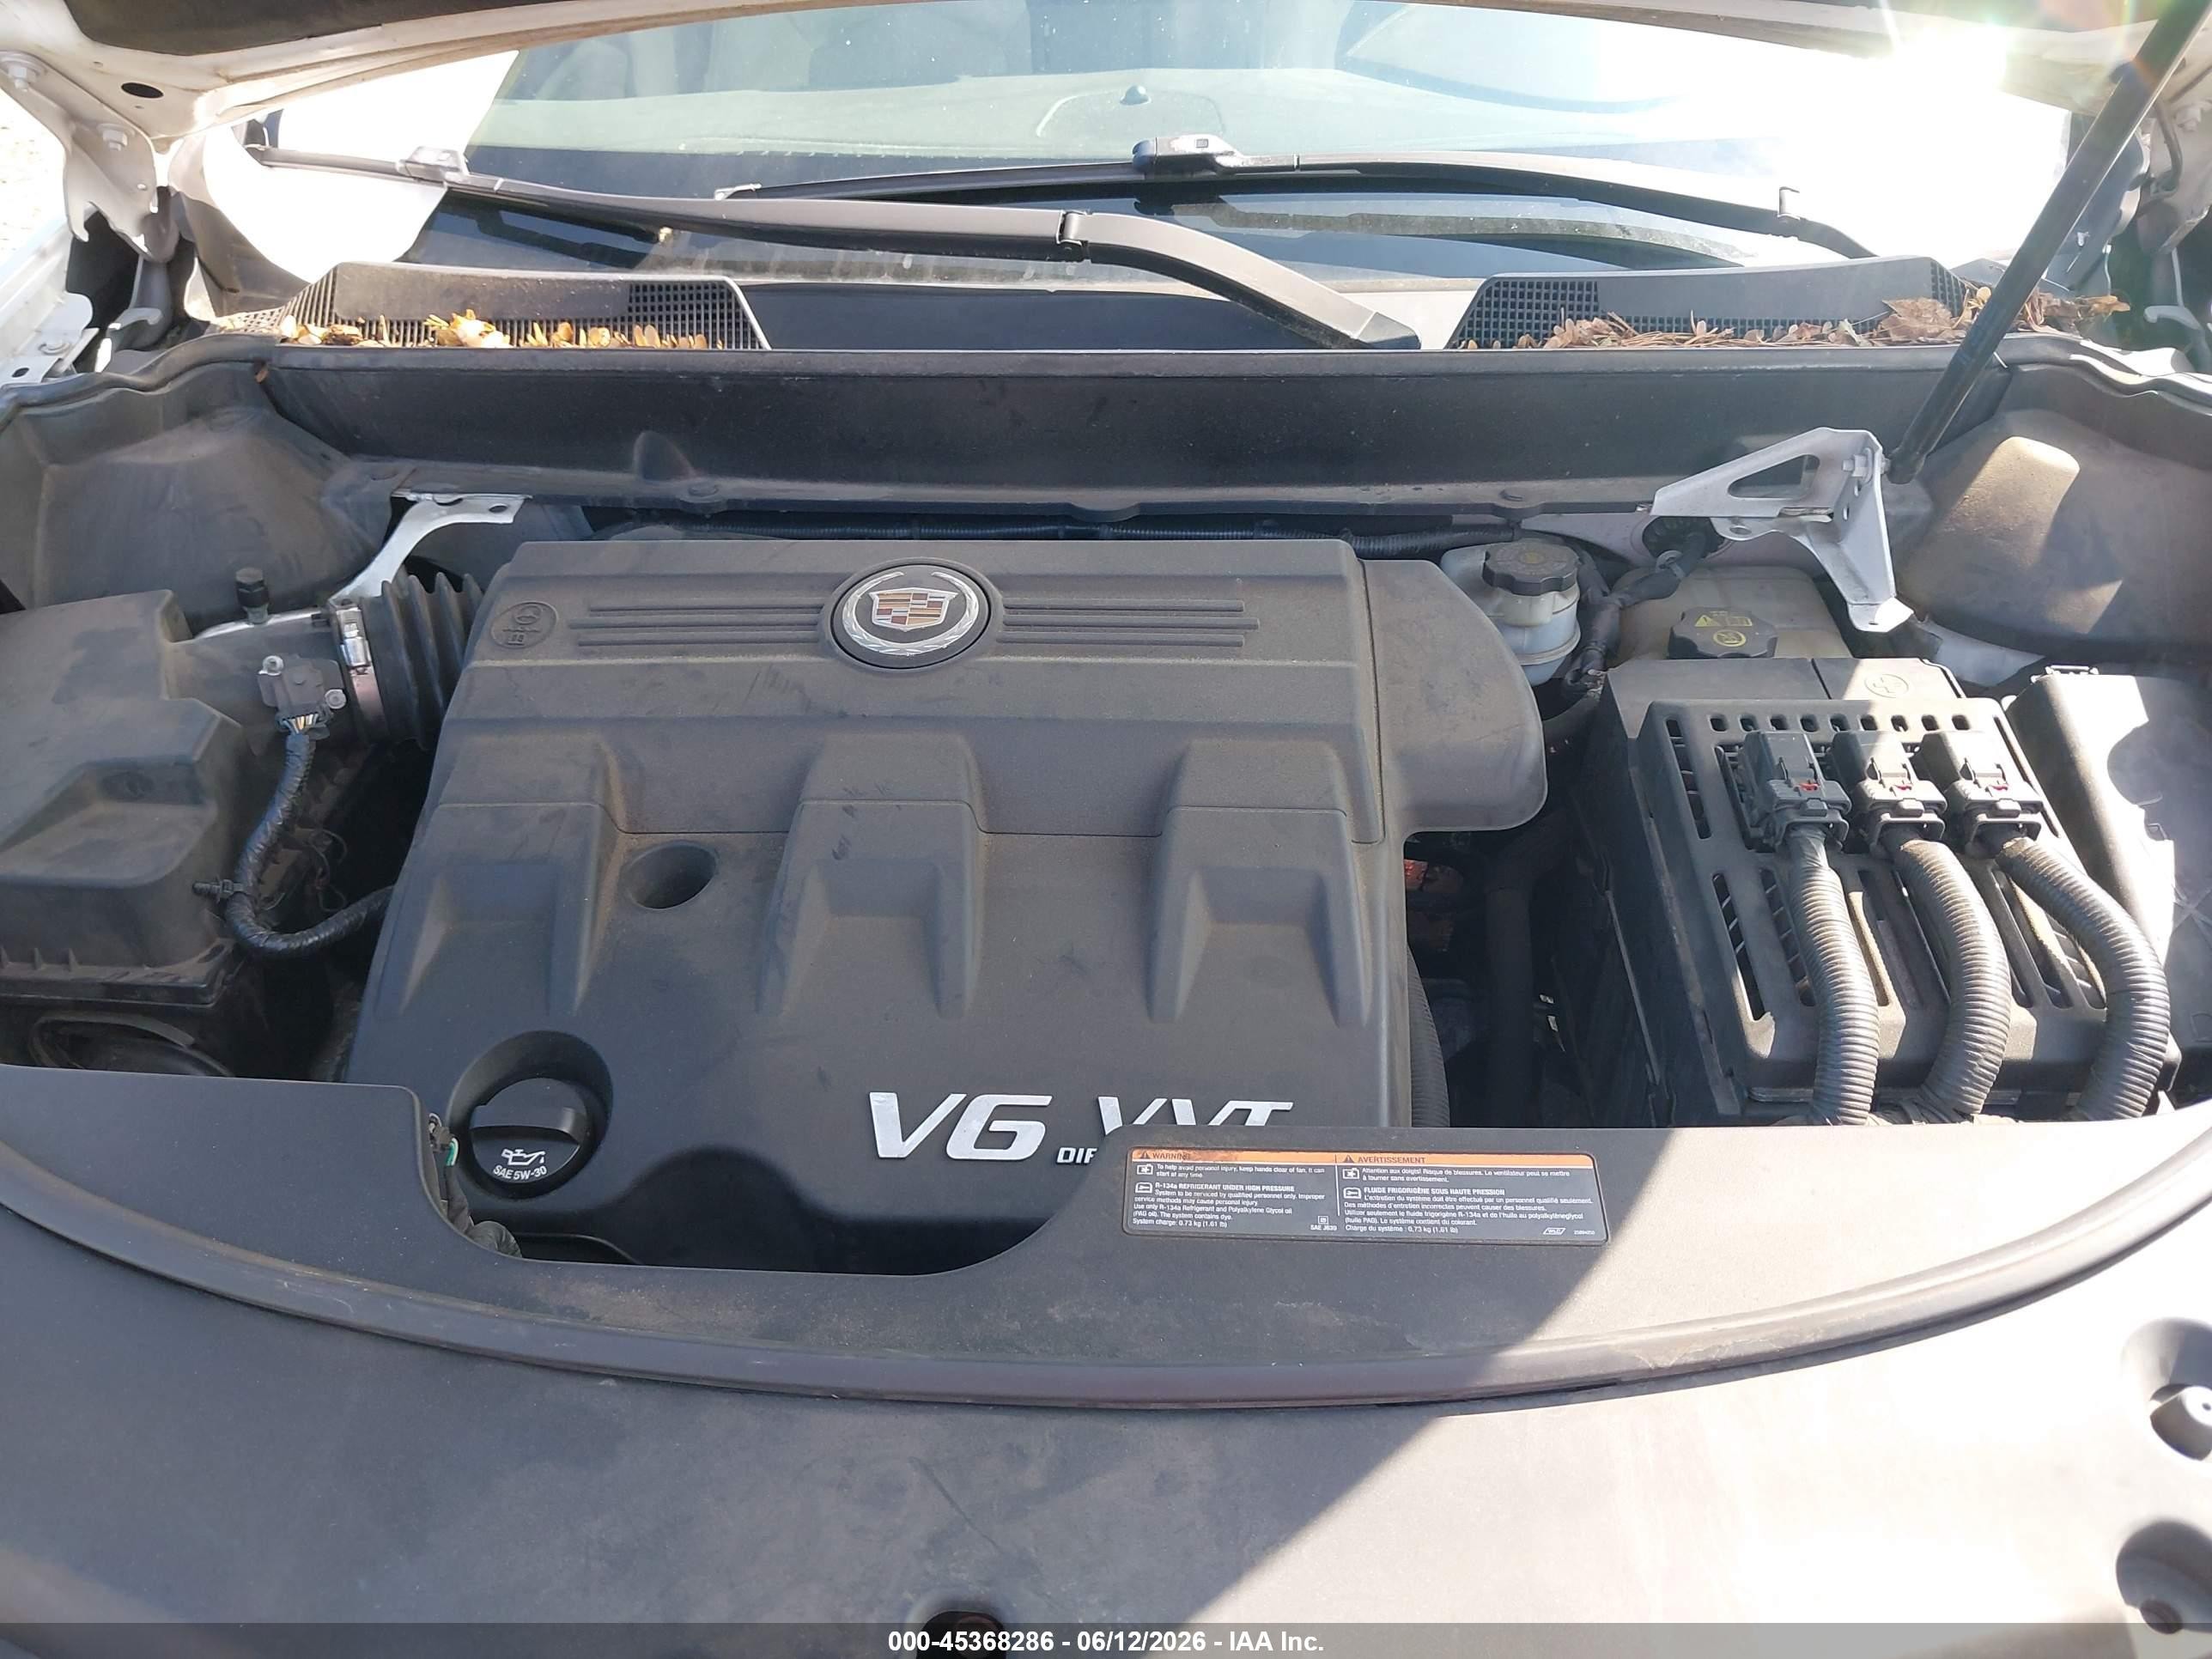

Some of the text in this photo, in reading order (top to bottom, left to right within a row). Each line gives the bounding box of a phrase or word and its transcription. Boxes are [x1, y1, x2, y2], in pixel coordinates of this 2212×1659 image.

[869, 1092, 1052, 1161] V6
[493, 1164, 547, 1180] SAE 5W-30
